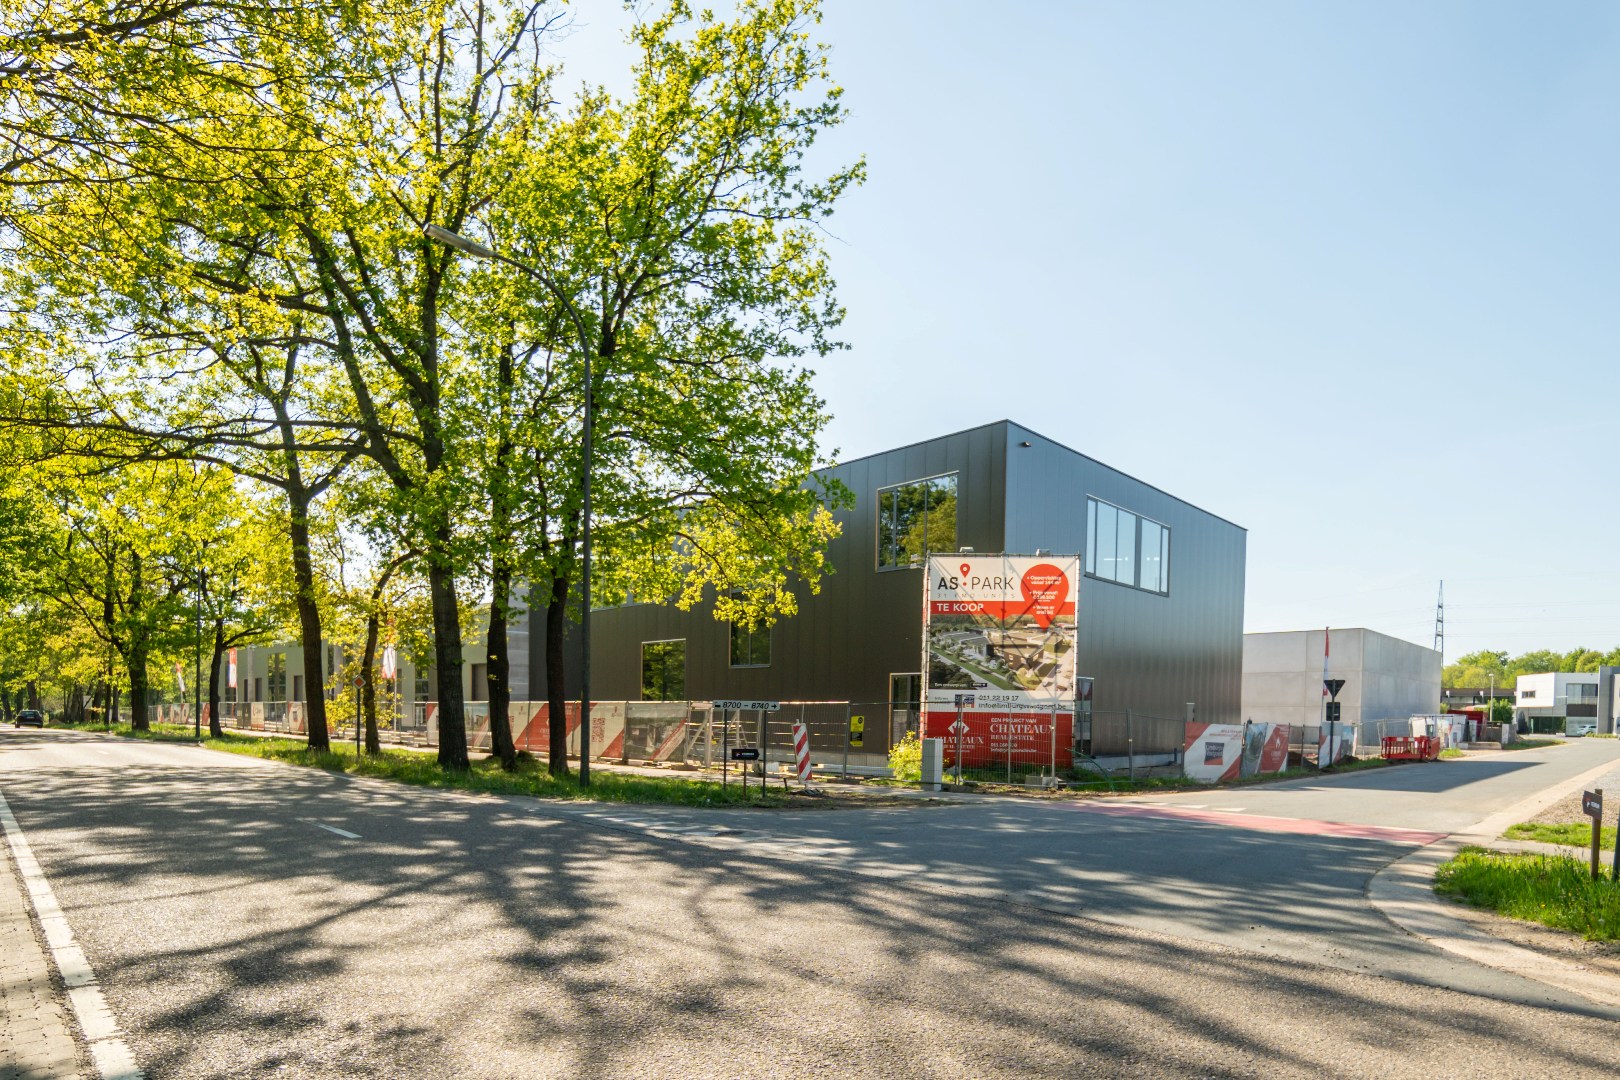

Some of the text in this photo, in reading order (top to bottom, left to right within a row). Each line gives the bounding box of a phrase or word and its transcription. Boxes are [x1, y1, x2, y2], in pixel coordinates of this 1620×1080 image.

[938, 577, 1014, 590] AS PARK
[937, 603, 984, 612] TE KOOP
